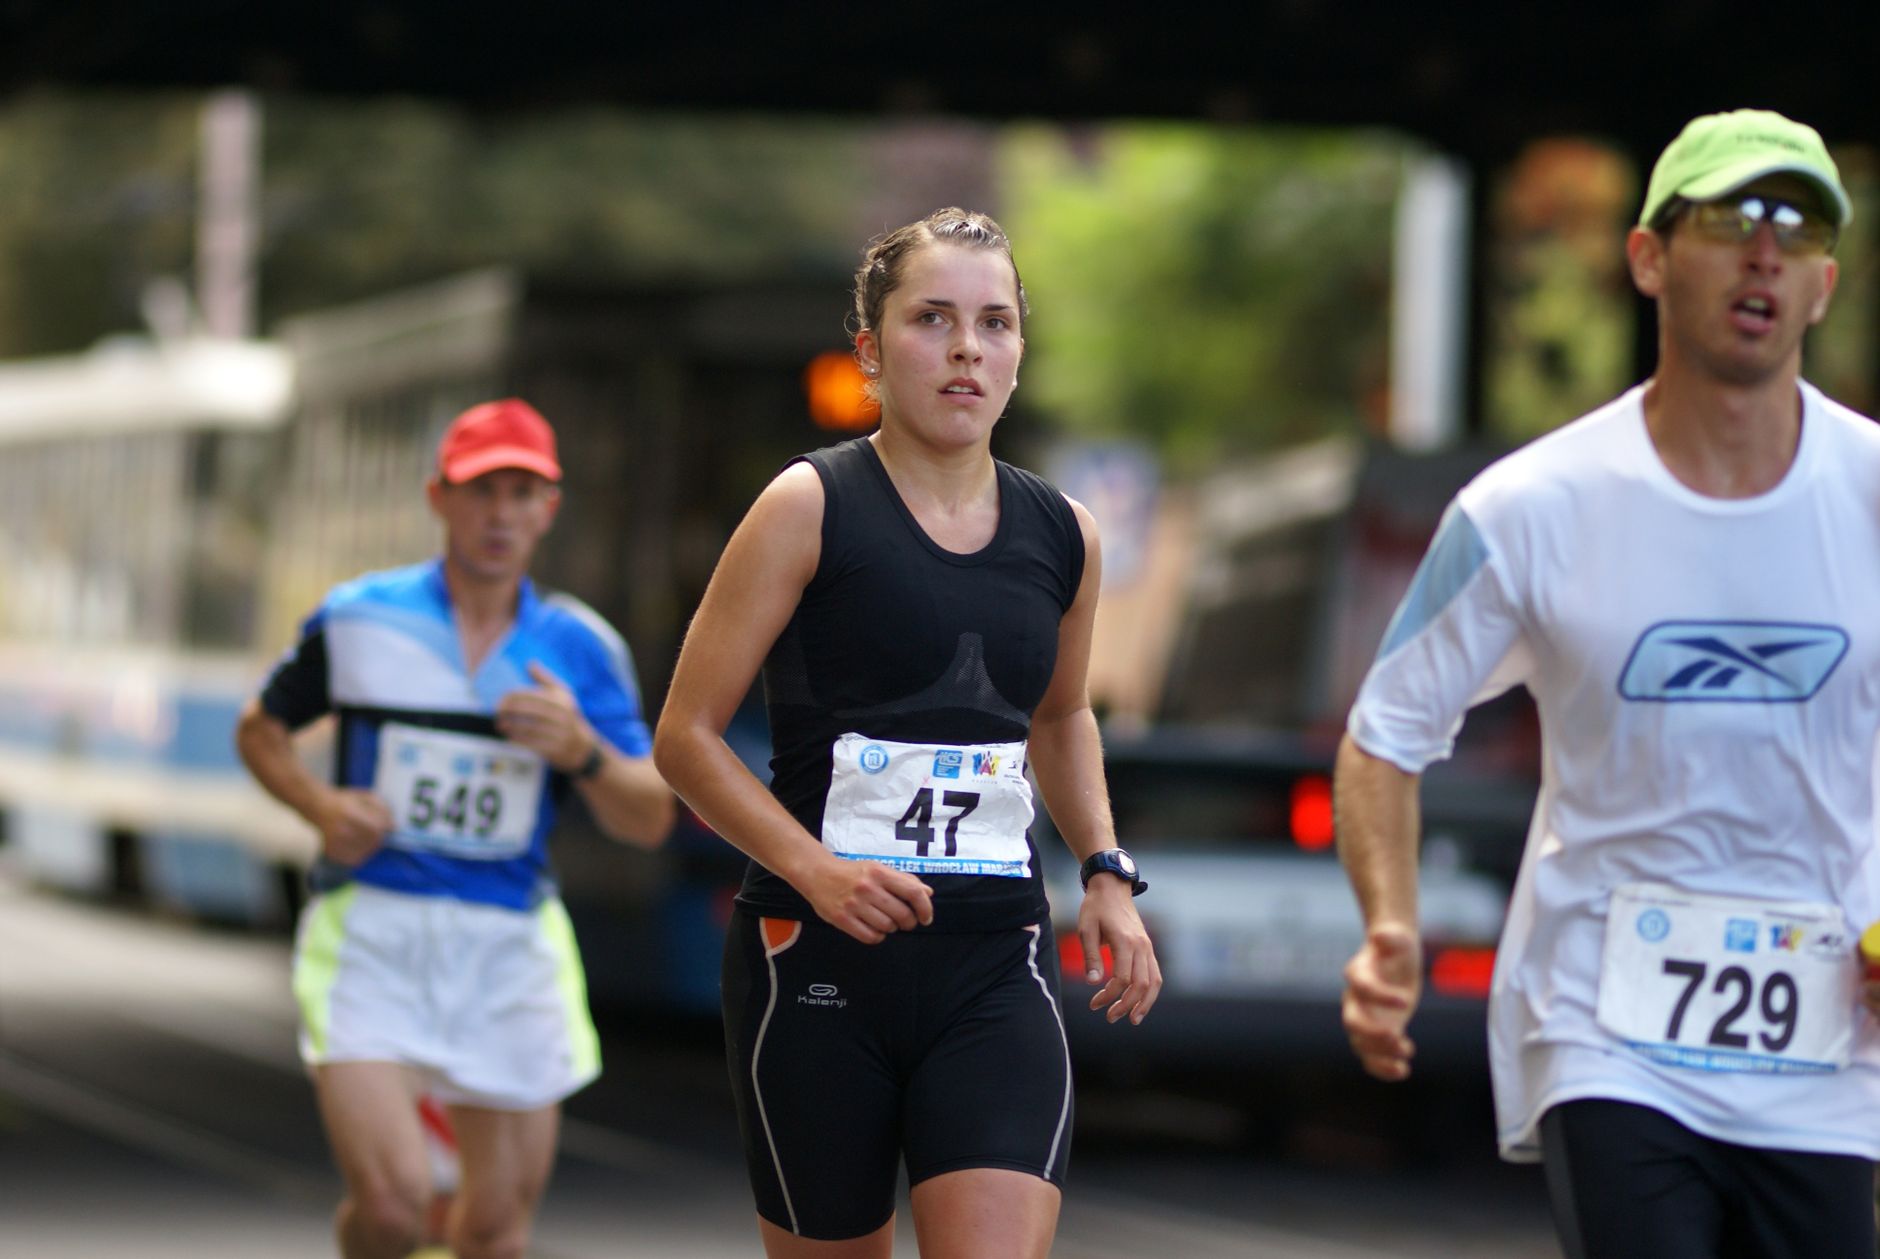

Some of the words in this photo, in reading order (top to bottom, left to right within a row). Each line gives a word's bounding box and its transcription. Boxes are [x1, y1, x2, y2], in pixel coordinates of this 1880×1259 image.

[408, 777, 502, 837] 549
[895, 787, 981, 857] 47
[797, 995, 848, 1009] Kalenji
[1662, 958, 1799, 1053] 729
